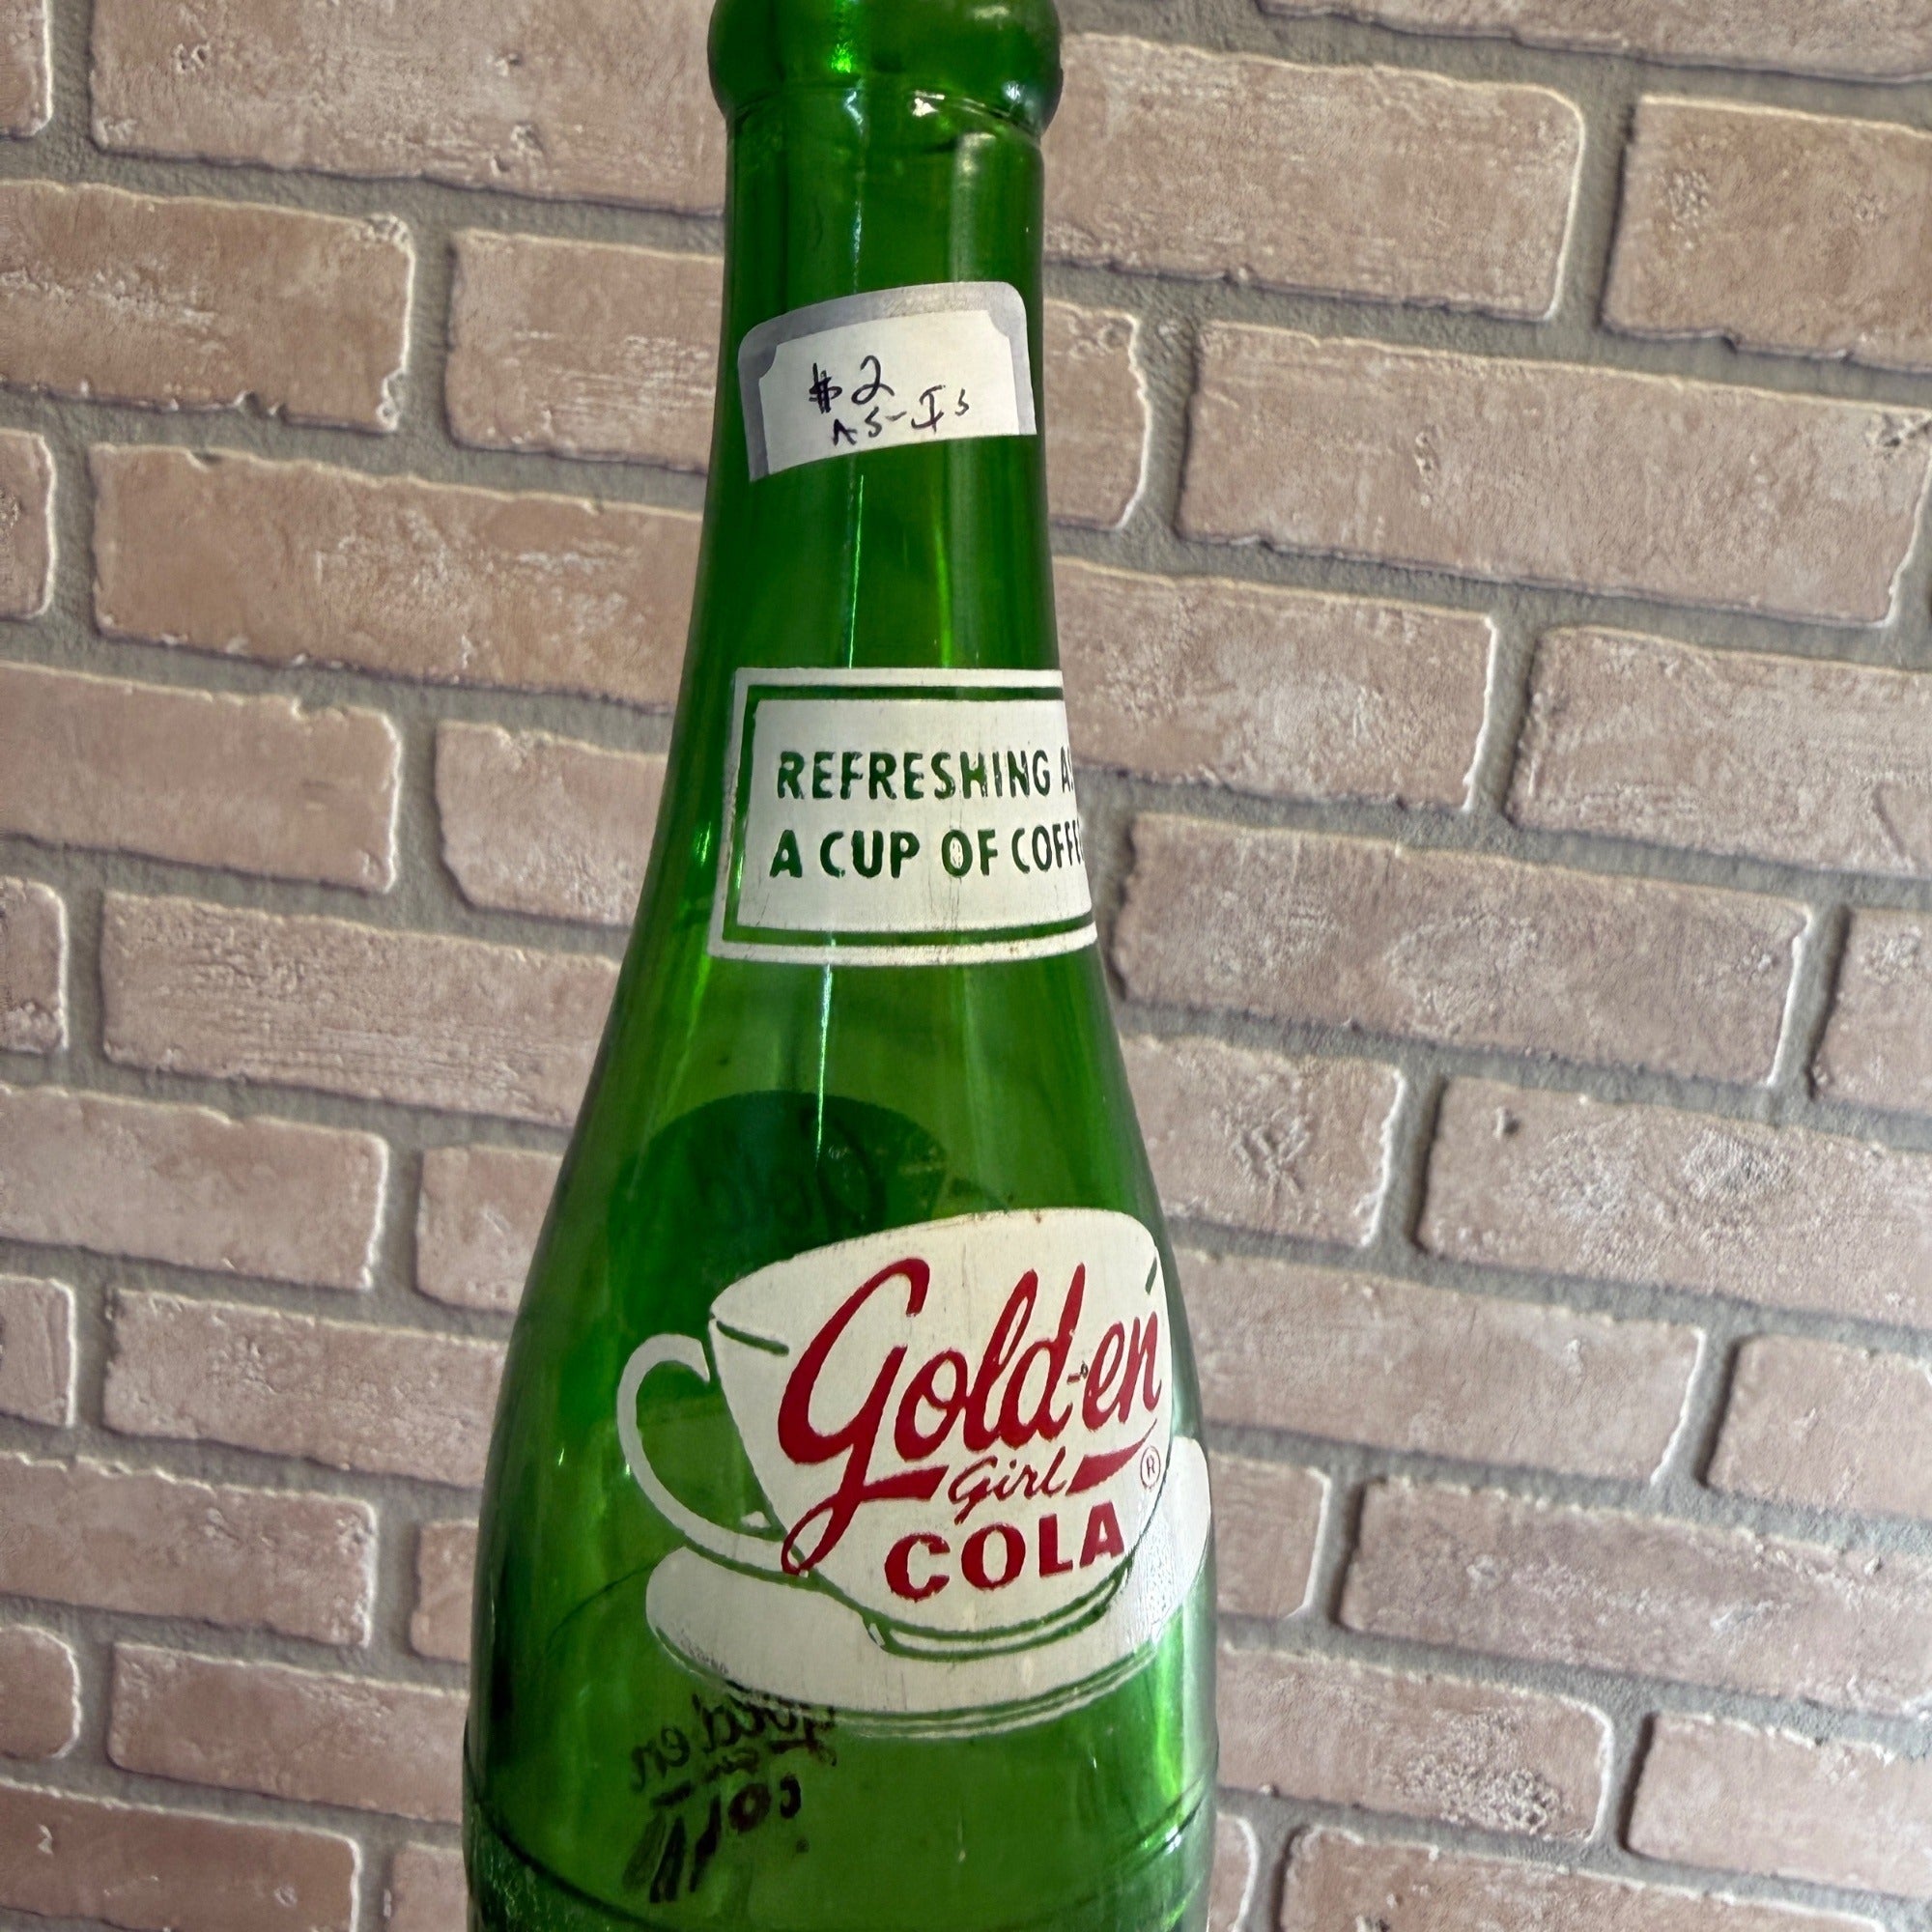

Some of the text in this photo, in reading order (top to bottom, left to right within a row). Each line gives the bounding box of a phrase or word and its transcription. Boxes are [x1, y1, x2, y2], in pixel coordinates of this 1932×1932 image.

[808, 354, 895, 413] $2
[777, 745, 1074, 800] REFRESHING A
[769, 817, 1083, 878] A CUP OF COFF
[884, 1500, 1125, 1603] COLA
